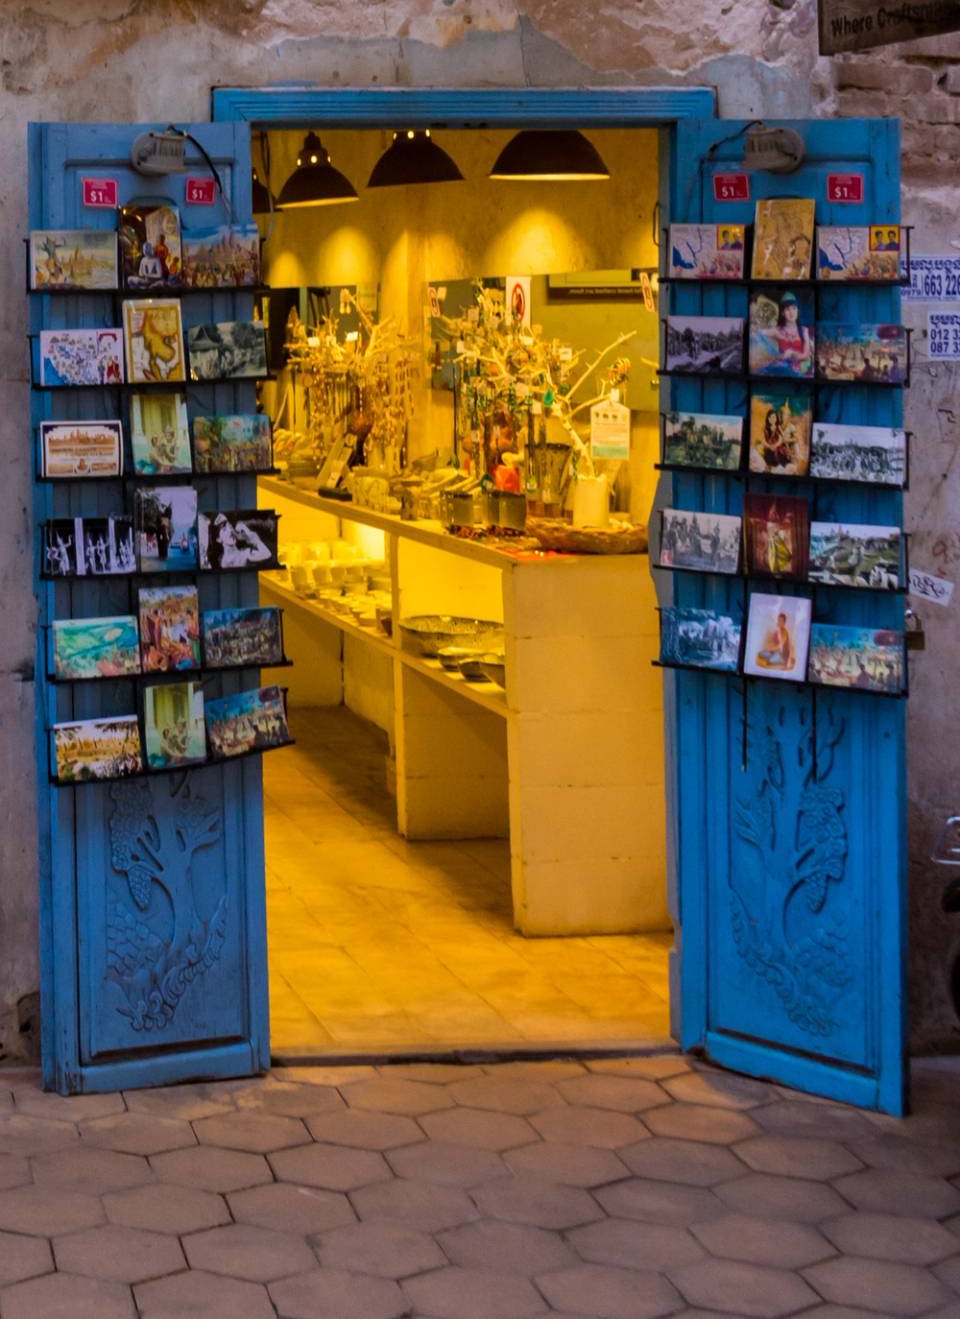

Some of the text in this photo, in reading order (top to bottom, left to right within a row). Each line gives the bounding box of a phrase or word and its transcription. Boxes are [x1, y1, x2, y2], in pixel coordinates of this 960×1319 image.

[831, 15, 873, 38] Where
[90, 190, 104, 203] $1
[191, 189, 203, 200] $1
[721, 186, 735, 198] $1
[834, 186, 848, 198] $1
[924, 274, 942, 296] 663
[930, 328, 950, 340] 012
[930, 341, 949, 353] 087
